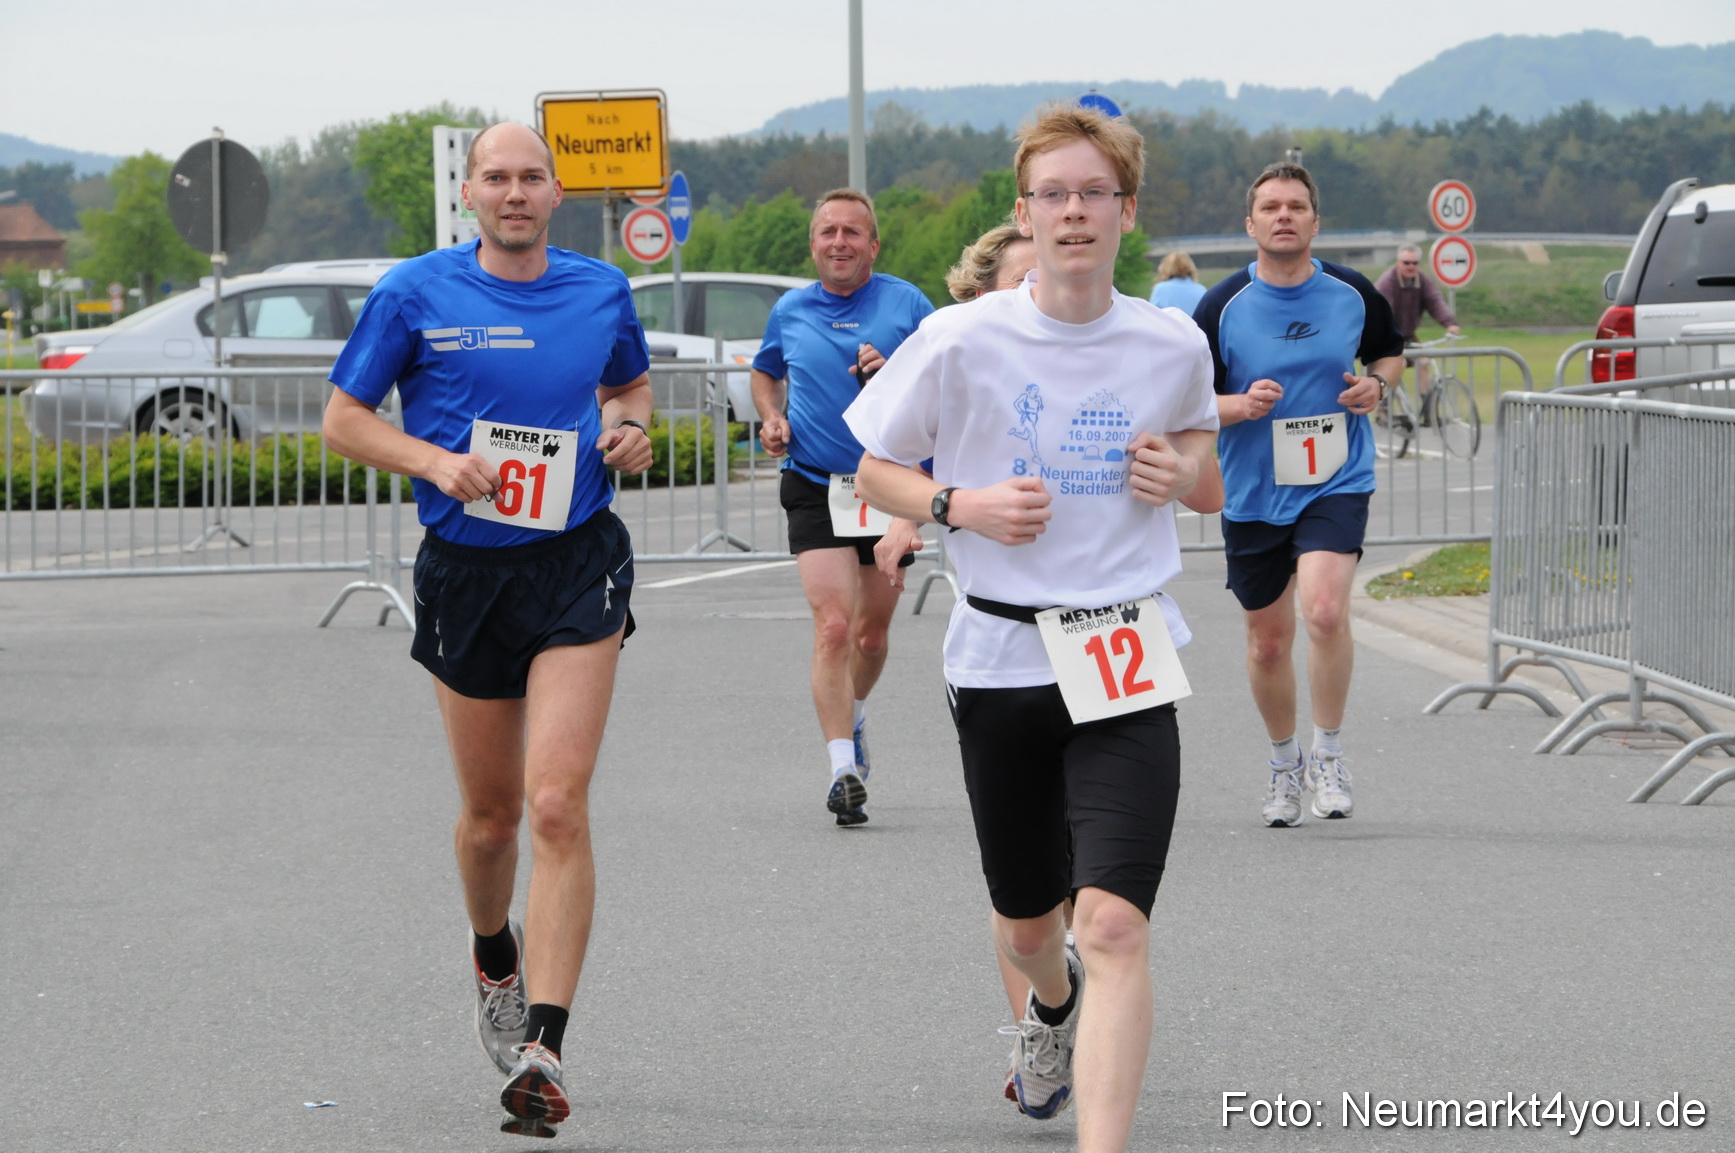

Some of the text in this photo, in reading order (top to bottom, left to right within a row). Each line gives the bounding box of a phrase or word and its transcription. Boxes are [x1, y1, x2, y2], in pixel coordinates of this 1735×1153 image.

[587, 114, 620, 125] Nach
[556, 131, 651, 154] Neumarkt
[589, 163, 624, 174] 5 km
[1441, 196, 1465, 218] 60
[1285, 420, 1319, 430] MEYER
[1286, 428, 1320, 436] WERBUNG
[490, 427, 540, 444] MEYER
[1068, 430, 1133, 442] 16.09.2007
[489, 439, 540, 454] WERBUNG
[1303, 437, 1316, 475] 1
[1012, 458, 1126, 482] 8. Neumarkter
[494, 459, 547, 520] 61
[1060, 481, 1124, 496] Stadtlauf
[1059, 604, 1115, 626] MEYER
[1062, 615, 1119, 635] WERBUNG
[1083, 627, 1156, 702] 12
